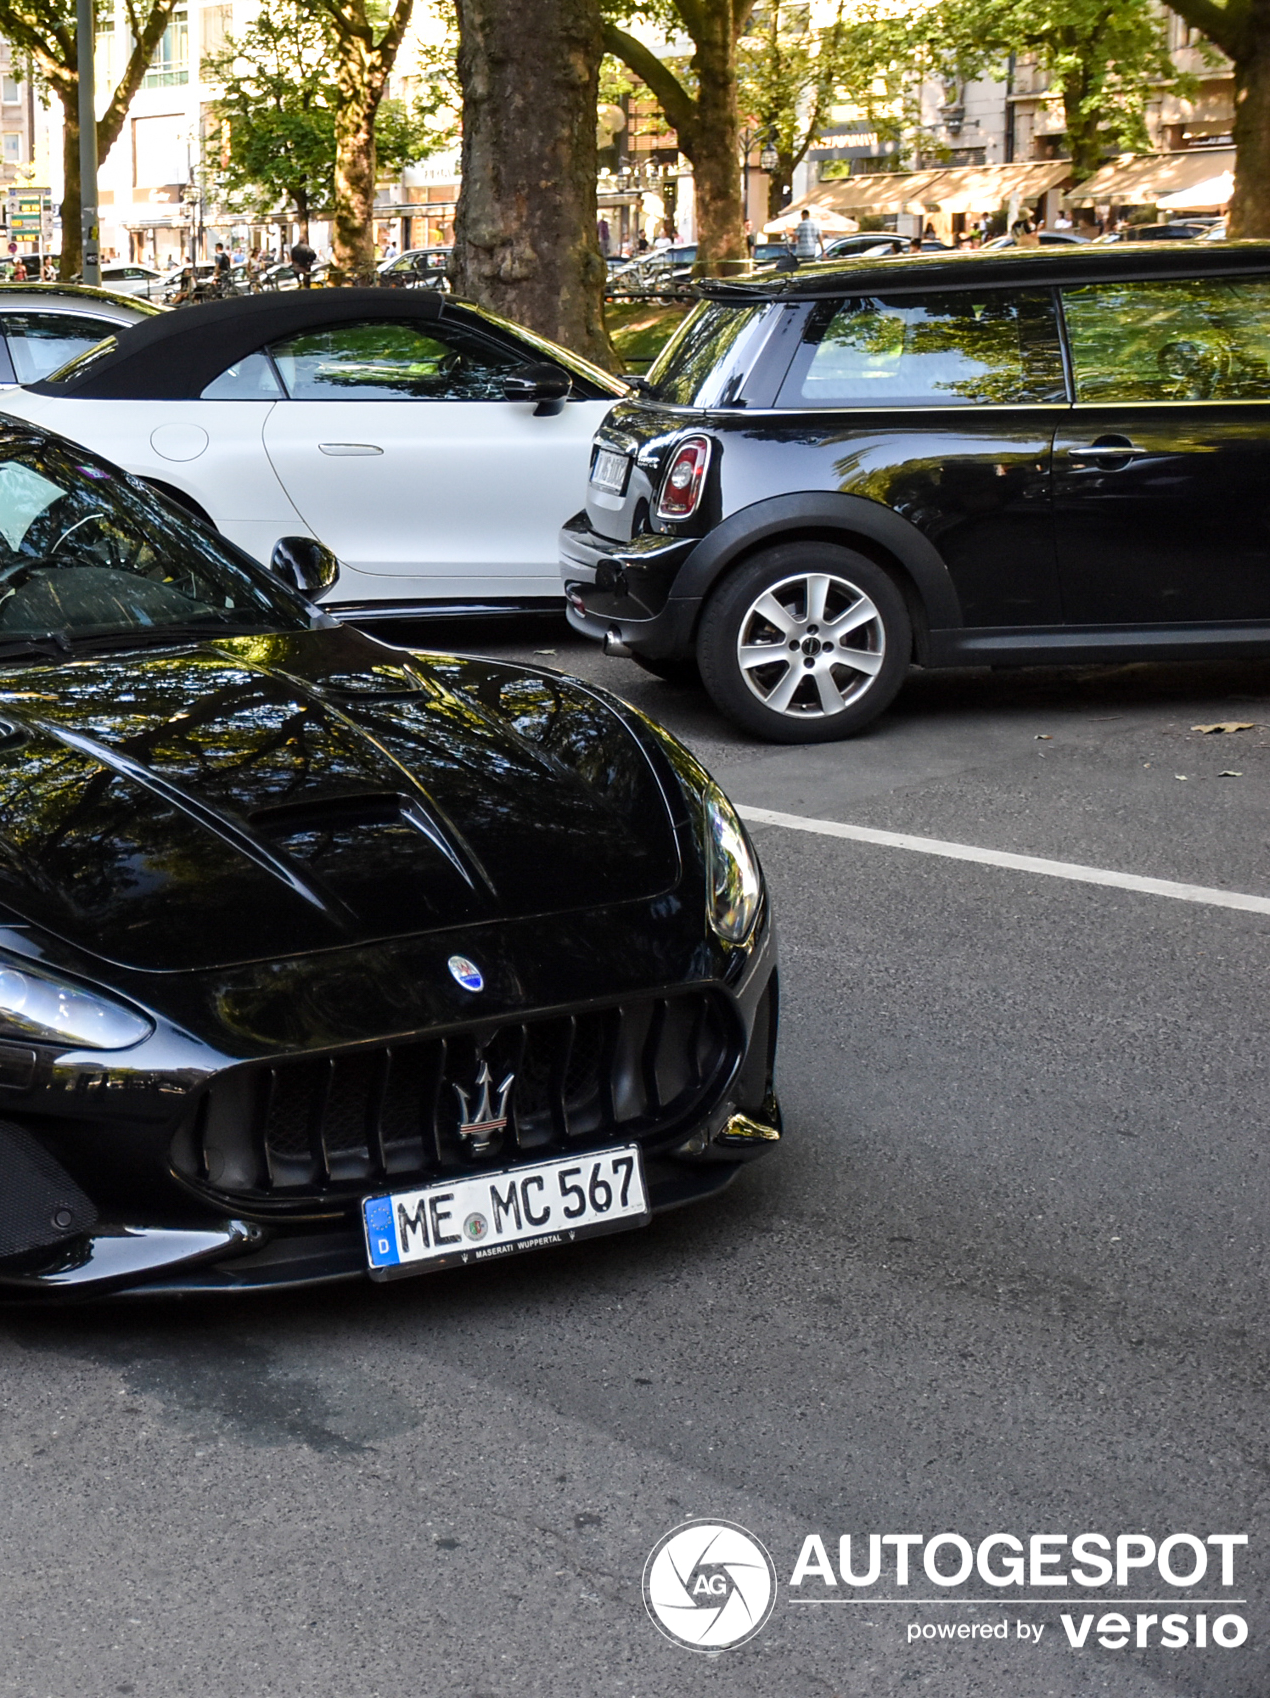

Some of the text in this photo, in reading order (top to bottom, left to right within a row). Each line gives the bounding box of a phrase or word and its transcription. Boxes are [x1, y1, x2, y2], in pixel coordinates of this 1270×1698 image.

[379, 1156, 634, 1255] D ME MC 567
[475, 1234, 563, 1259] MASERATI WUPPERTAL
